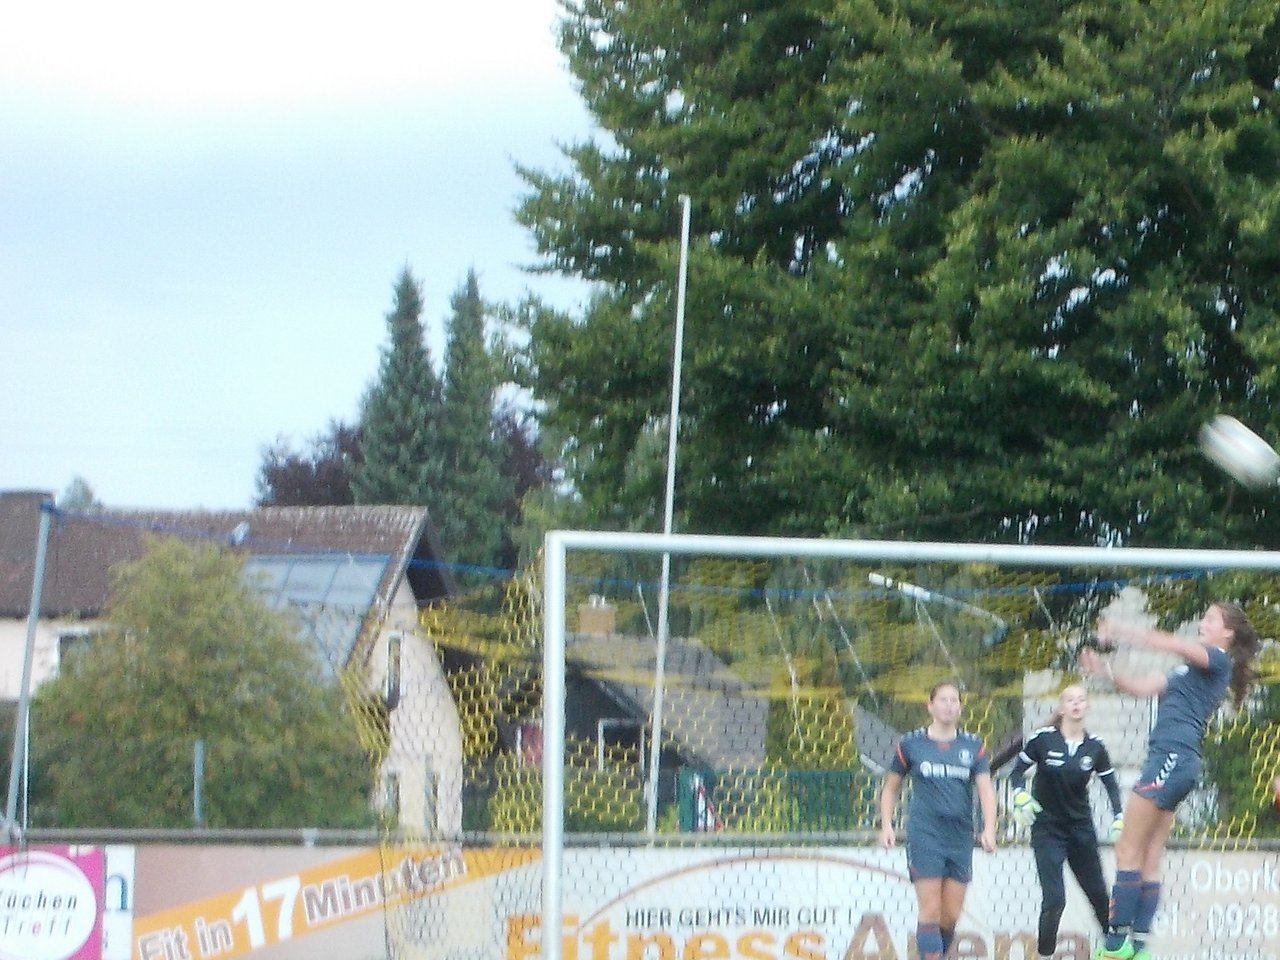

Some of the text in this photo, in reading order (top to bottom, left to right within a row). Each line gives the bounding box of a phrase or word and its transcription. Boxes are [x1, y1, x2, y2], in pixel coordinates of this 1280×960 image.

[196, 916, 234, 957] in
[232, 874, 301, 949] 17
[302, 851, 466, 926] Minuten
[753, 906, 790, 926] MIR
[797, 906, 838, 925] GUT
